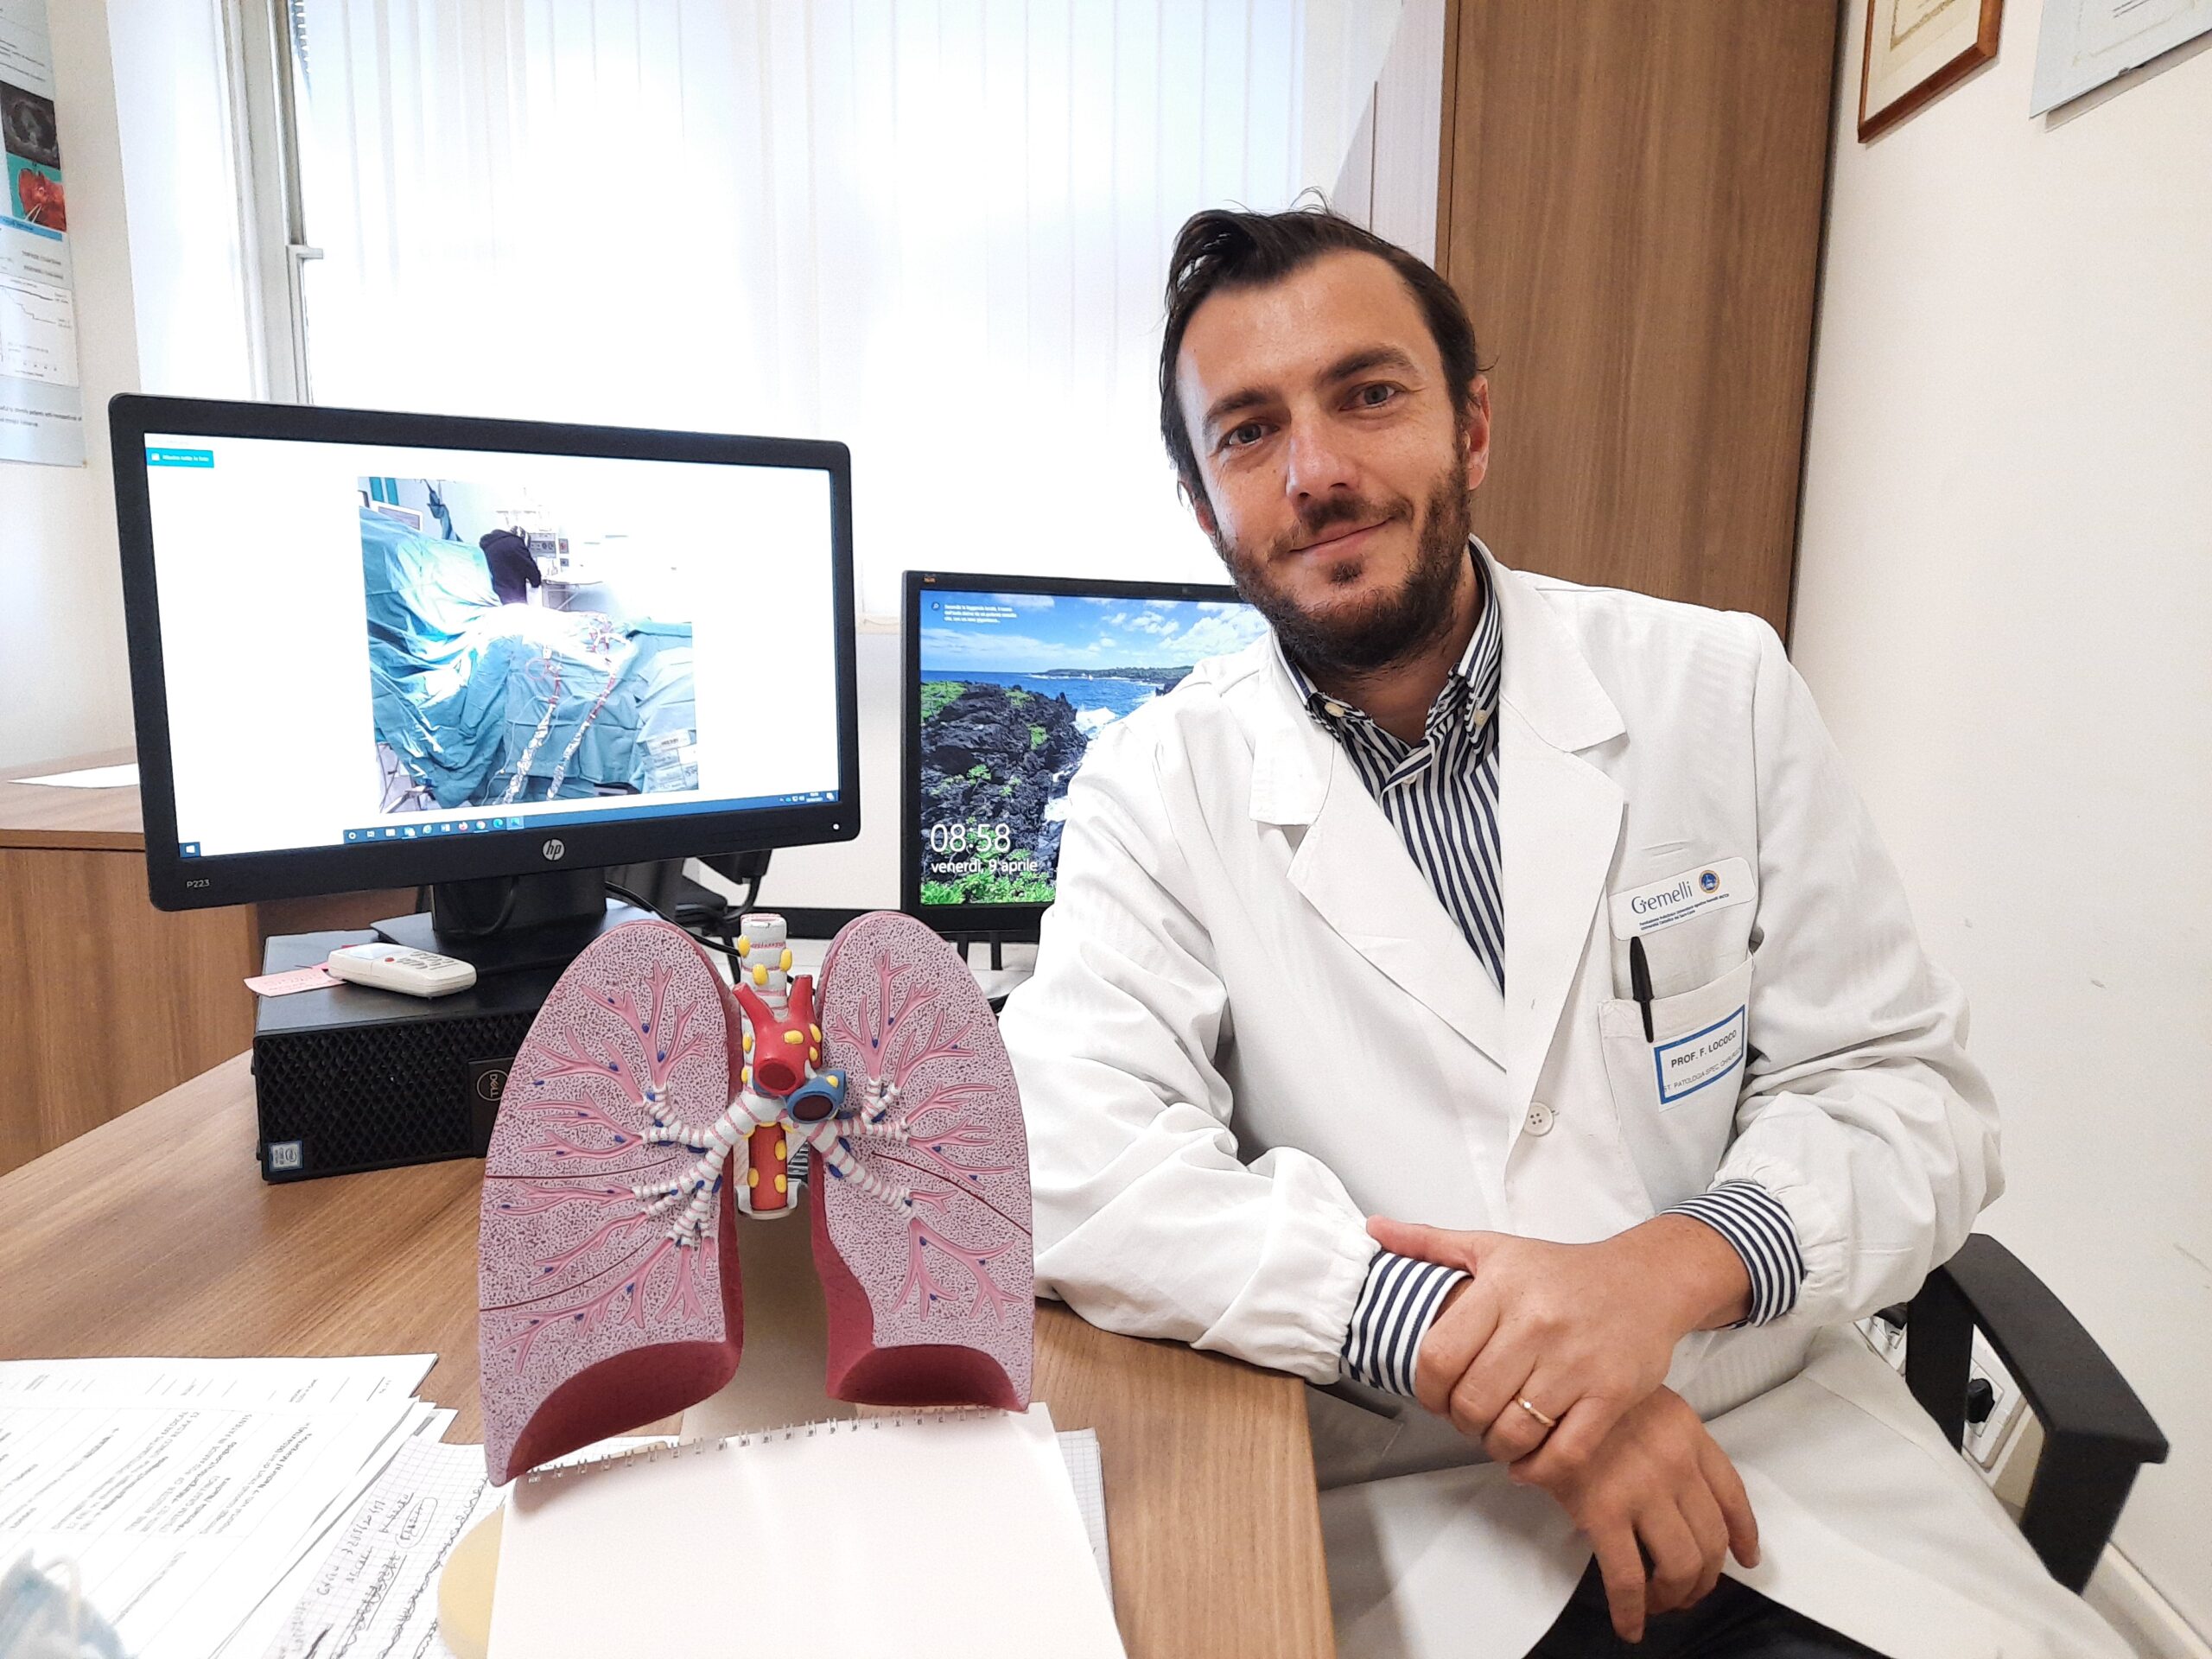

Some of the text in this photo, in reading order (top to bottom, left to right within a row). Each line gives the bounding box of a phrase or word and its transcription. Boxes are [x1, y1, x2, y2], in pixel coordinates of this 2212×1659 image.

[545, 839, 563, 861] hp
[931, 823, 1011, 852] 08:58
[988, 859, 997, 873] 9
[1001, 859, 1037, 875] aprile
[186, 879, 210, 888] P223
[1631, 880, 1693, 914] Gemelli
[1671, 1029, 1737, 1068] PROF. F. LOCOCO
